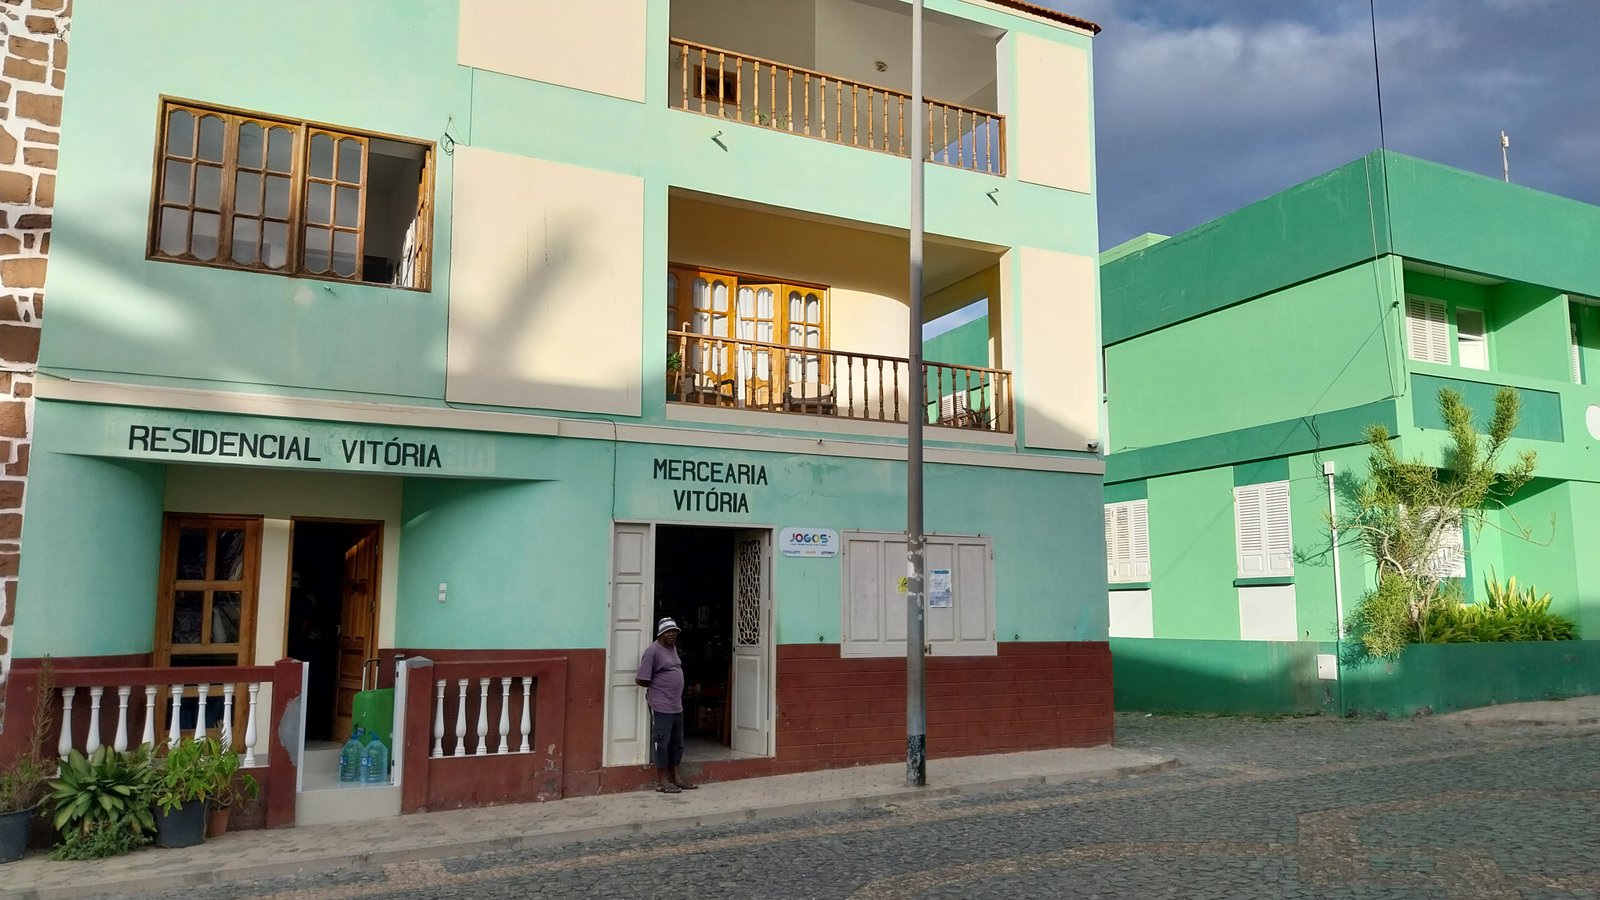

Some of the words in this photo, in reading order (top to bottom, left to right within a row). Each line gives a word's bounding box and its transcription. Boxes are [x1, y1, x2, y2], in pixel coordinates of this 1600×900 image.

[128, 425, 321, 461] RESIDENCIAL
[341, 437, 442, 468] VITÓRIA
[653, 458, 768, 486] MERCEARIA
[673, 487, 750, 513] VITÓRIA
[789, 533, 828, 543] JOGOS
